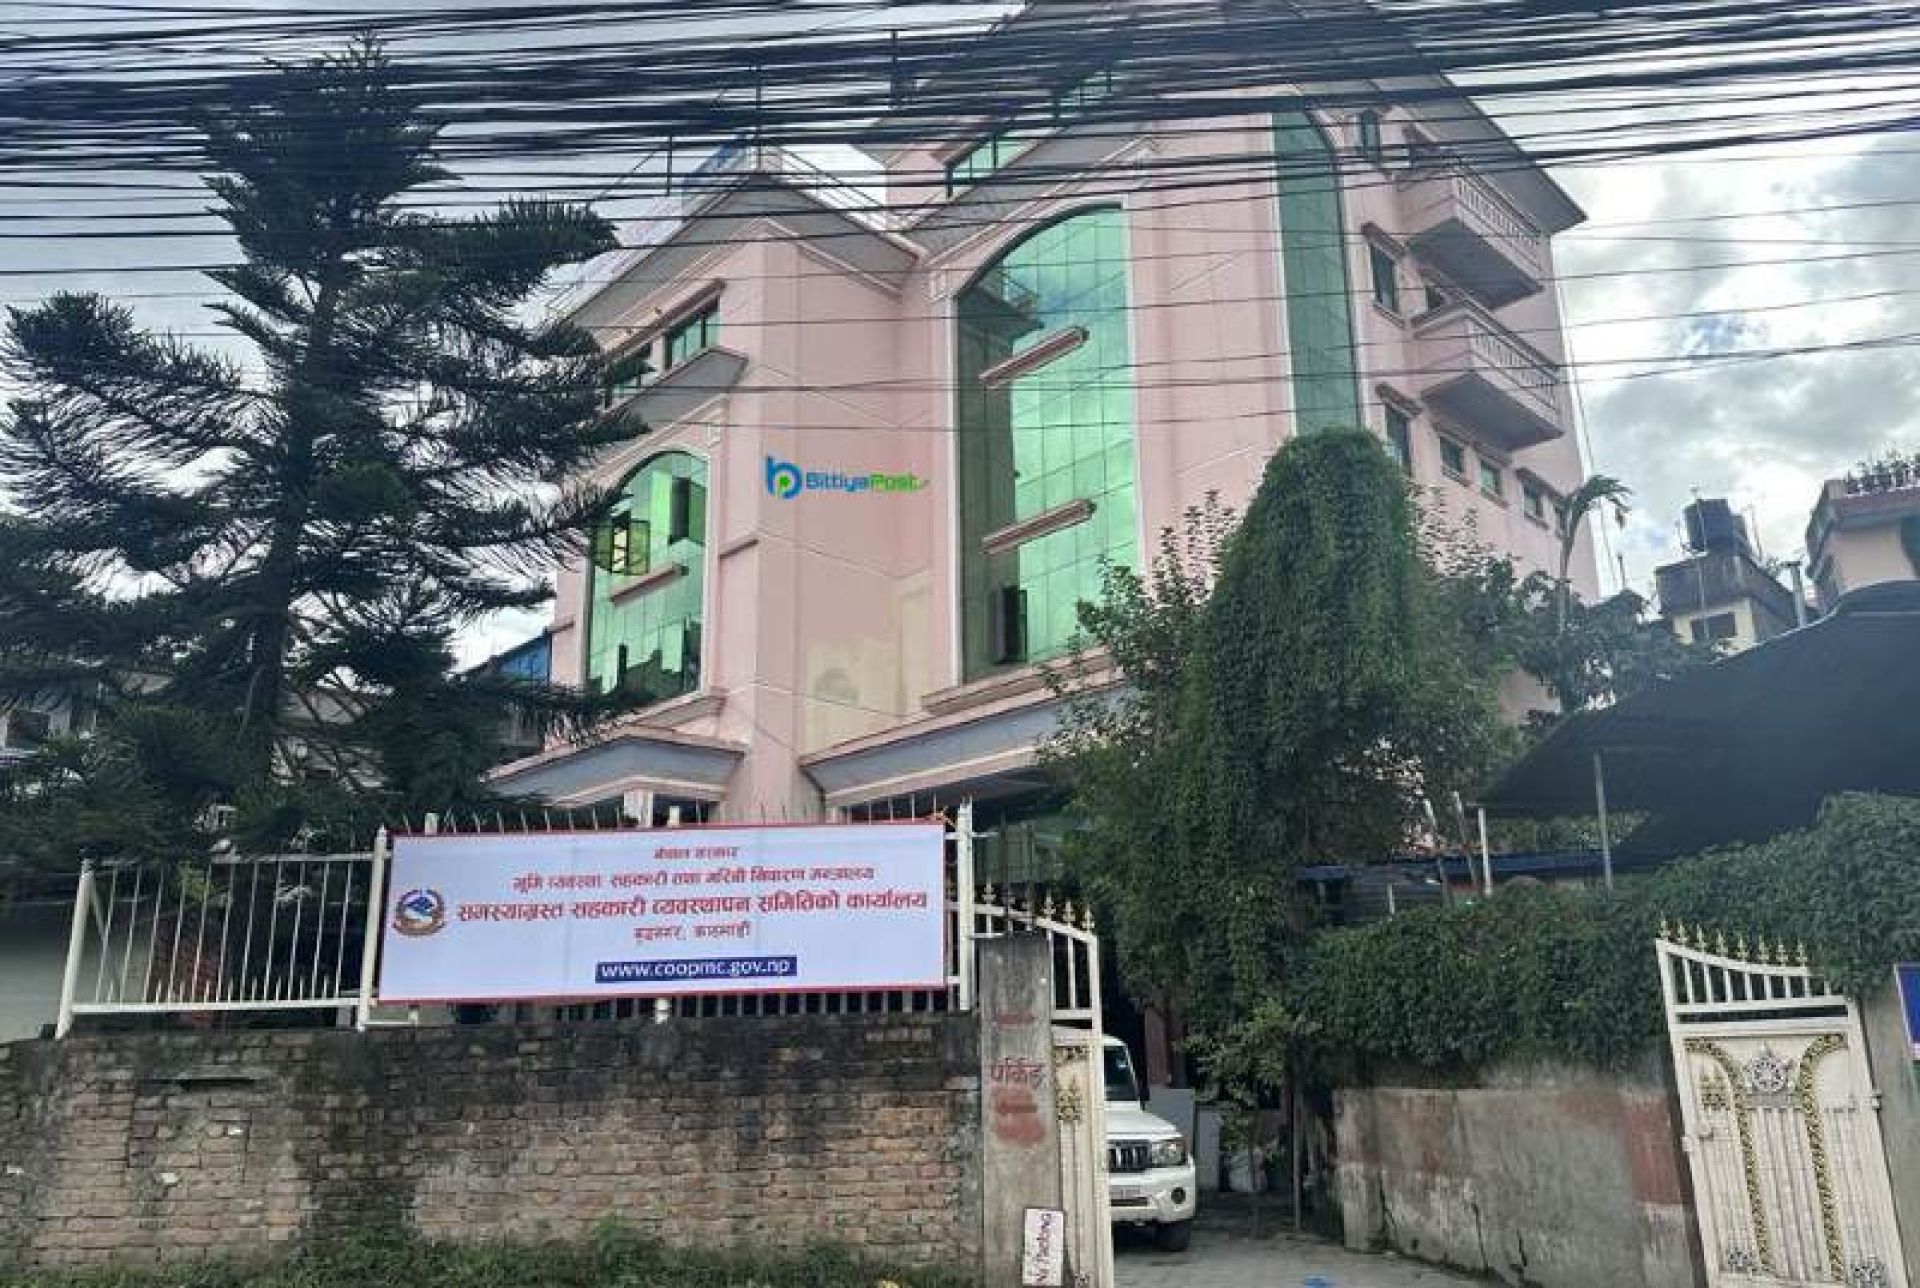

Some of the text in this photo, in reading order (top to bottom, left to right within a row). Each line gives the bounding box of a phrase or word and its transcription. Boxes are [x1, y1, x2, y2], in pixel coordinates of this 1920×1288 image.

[571, 895, 647, 918] सहकारी
[652, 897, 751, 914] व्यवस्थापन
[757, 890, 840, 912] समितिको
[846, 888, 928, 909] कार्यालय
[600, 958, 791, 978] www.coopmc.gov.np
